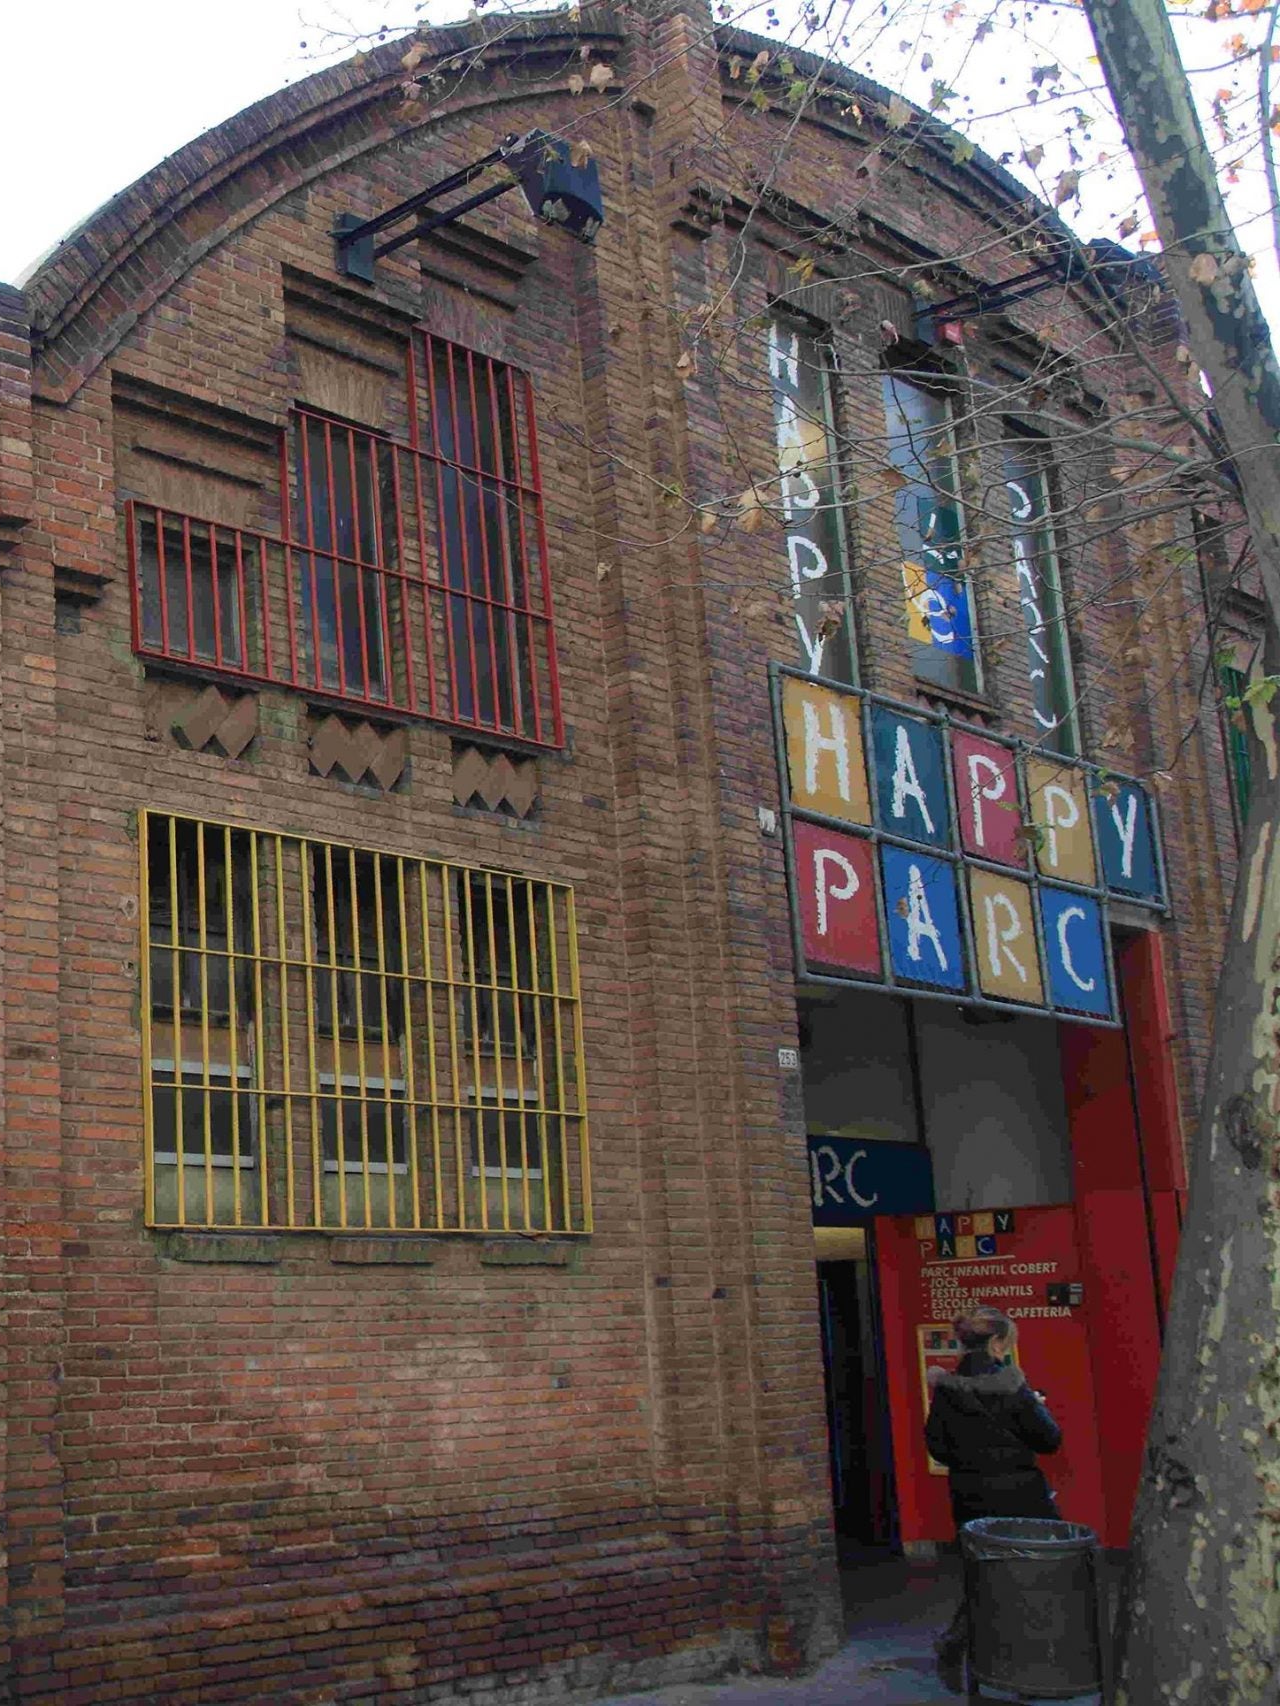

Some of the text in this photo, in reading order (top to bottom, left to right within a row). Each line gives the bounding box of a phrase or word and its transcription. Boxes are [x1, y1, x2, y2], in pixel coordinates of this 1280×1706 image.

[803, 700, 1137, 878] HAPPY
[813, 848, 1095, 992] PARC
[811, 1146, 878, 1207] RC
[920, 1213, 1009, 1237] HAPPY
[920, 1237, 993, 1258] PARC
[921, 1262, 1058, 1278] PARC INFANTIL COBERT
[929, 1277, 958, 1288] JOCS
[931, 1285, 1033, 1299] FESTES INFANTILS
[1007, 1306, 1072, 1319] CAFETERIA
